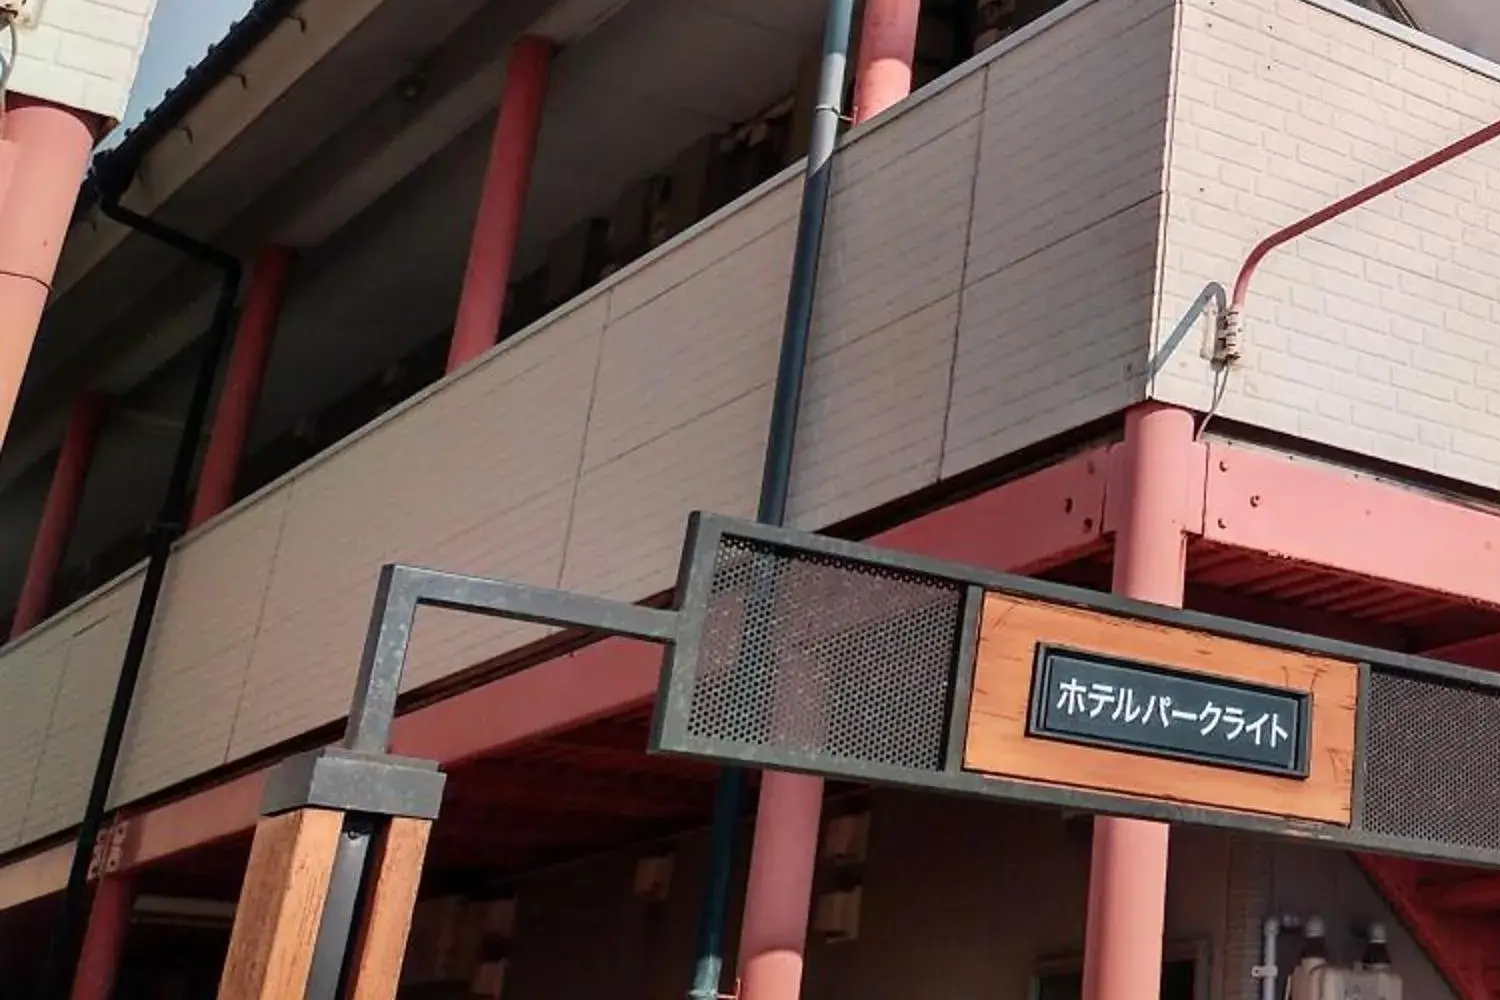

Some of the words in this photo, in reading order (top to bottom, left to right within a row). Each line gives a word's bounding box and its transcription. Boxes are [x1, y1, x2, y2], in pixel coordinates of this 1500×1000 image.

[1057, 678, 1288, 748] ホテルパークライト
